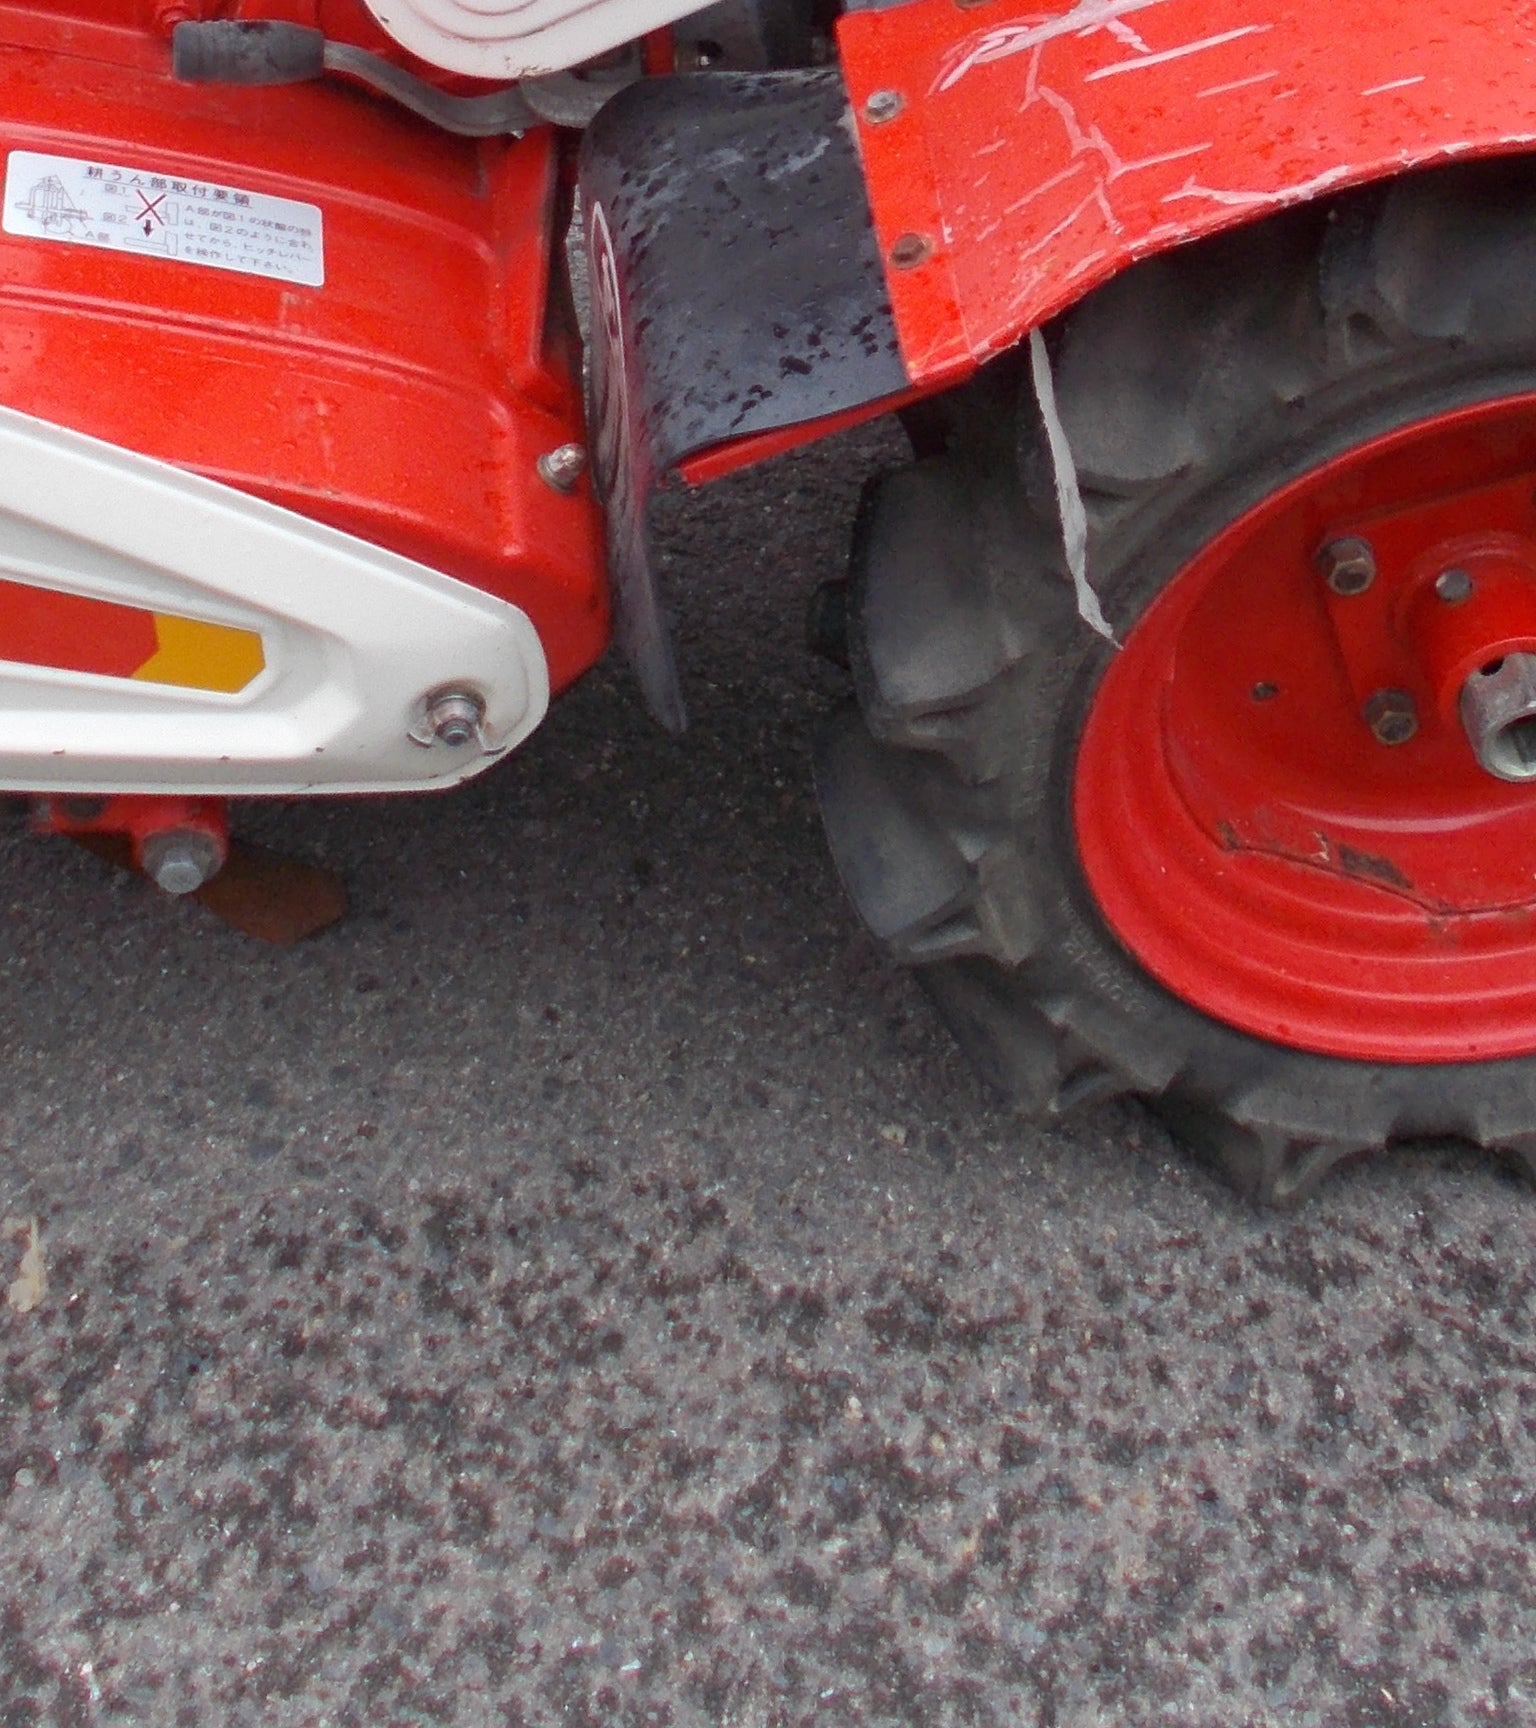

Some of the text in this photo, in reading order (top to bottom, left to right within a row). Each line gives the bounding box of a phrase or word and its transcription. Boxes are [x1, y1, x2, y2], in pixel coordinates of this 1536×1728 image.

[86, 165, 251, 206] 耕うん部取付要領
